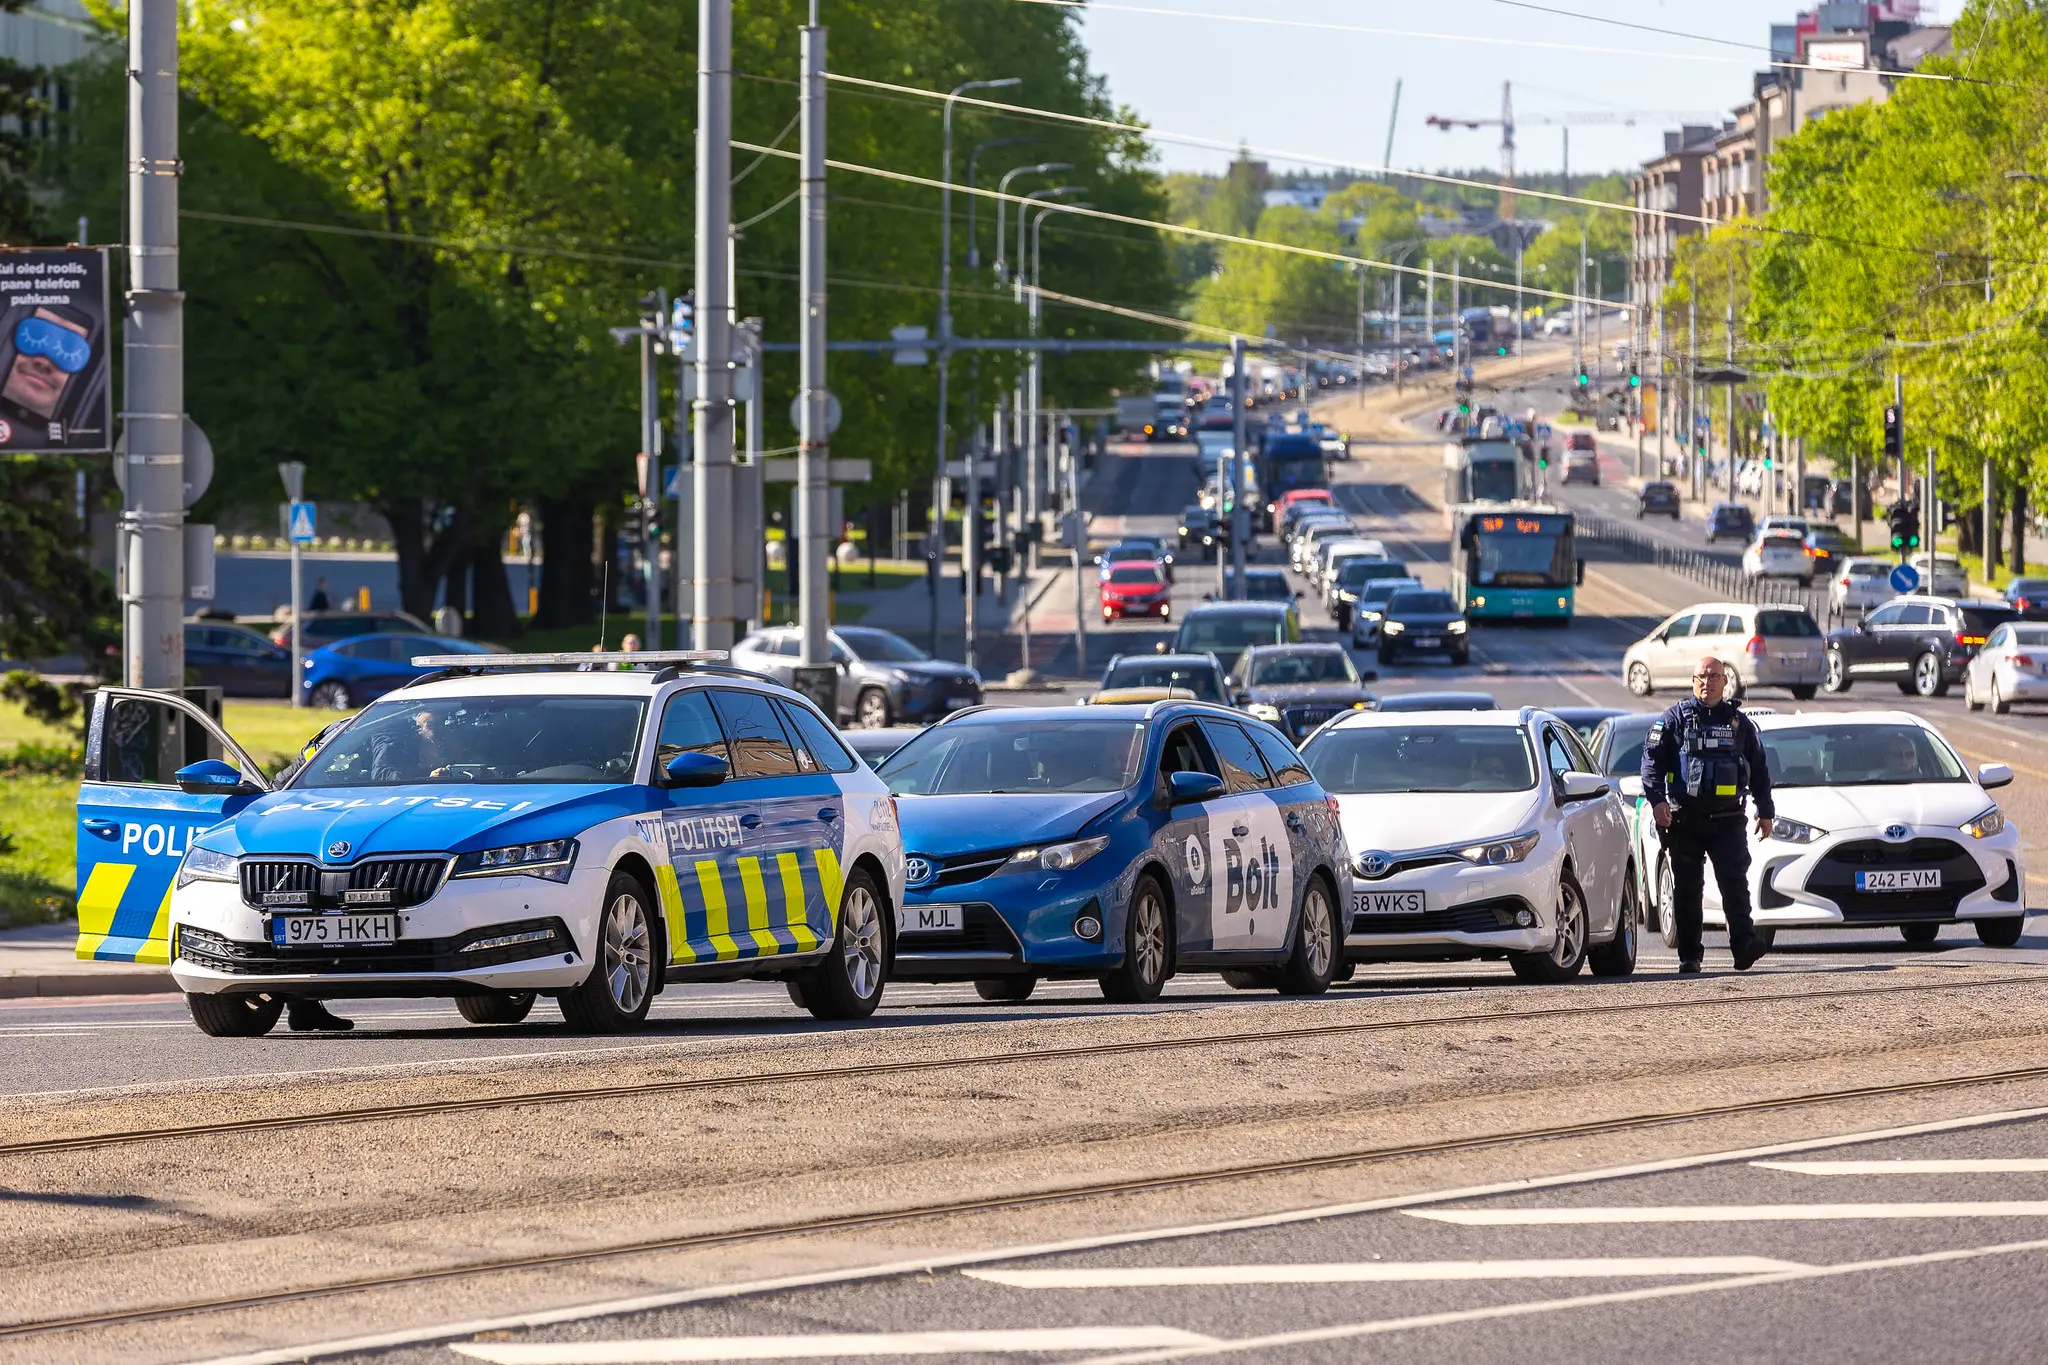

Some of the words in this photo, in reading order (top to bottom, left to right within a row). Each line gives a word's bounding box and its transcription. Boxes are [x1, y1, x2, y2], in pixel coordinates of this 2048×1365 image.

[16, 263, 45, 274] oled
[47, 262, 87, 276] roolis,
[1, 280, 32, 292] pane
[34, 278, 80, 290] telefon
[10, 294, 70, 307] puhkama
[259, 796, 534, 817] POLITSEI
[667, 814, 744, 852] POLITSEI
[1223, 835, 1279, 915] Bolt
[1869, 873, 1896, 888] 242
[1900, 871, 1937, 887] FVM
[1374, 894, 1419, 911] WKS
[919, 910, 955, 928] MJL
[290, 919, 329, 941] 975
[338, 917, 389, 939] HKH
